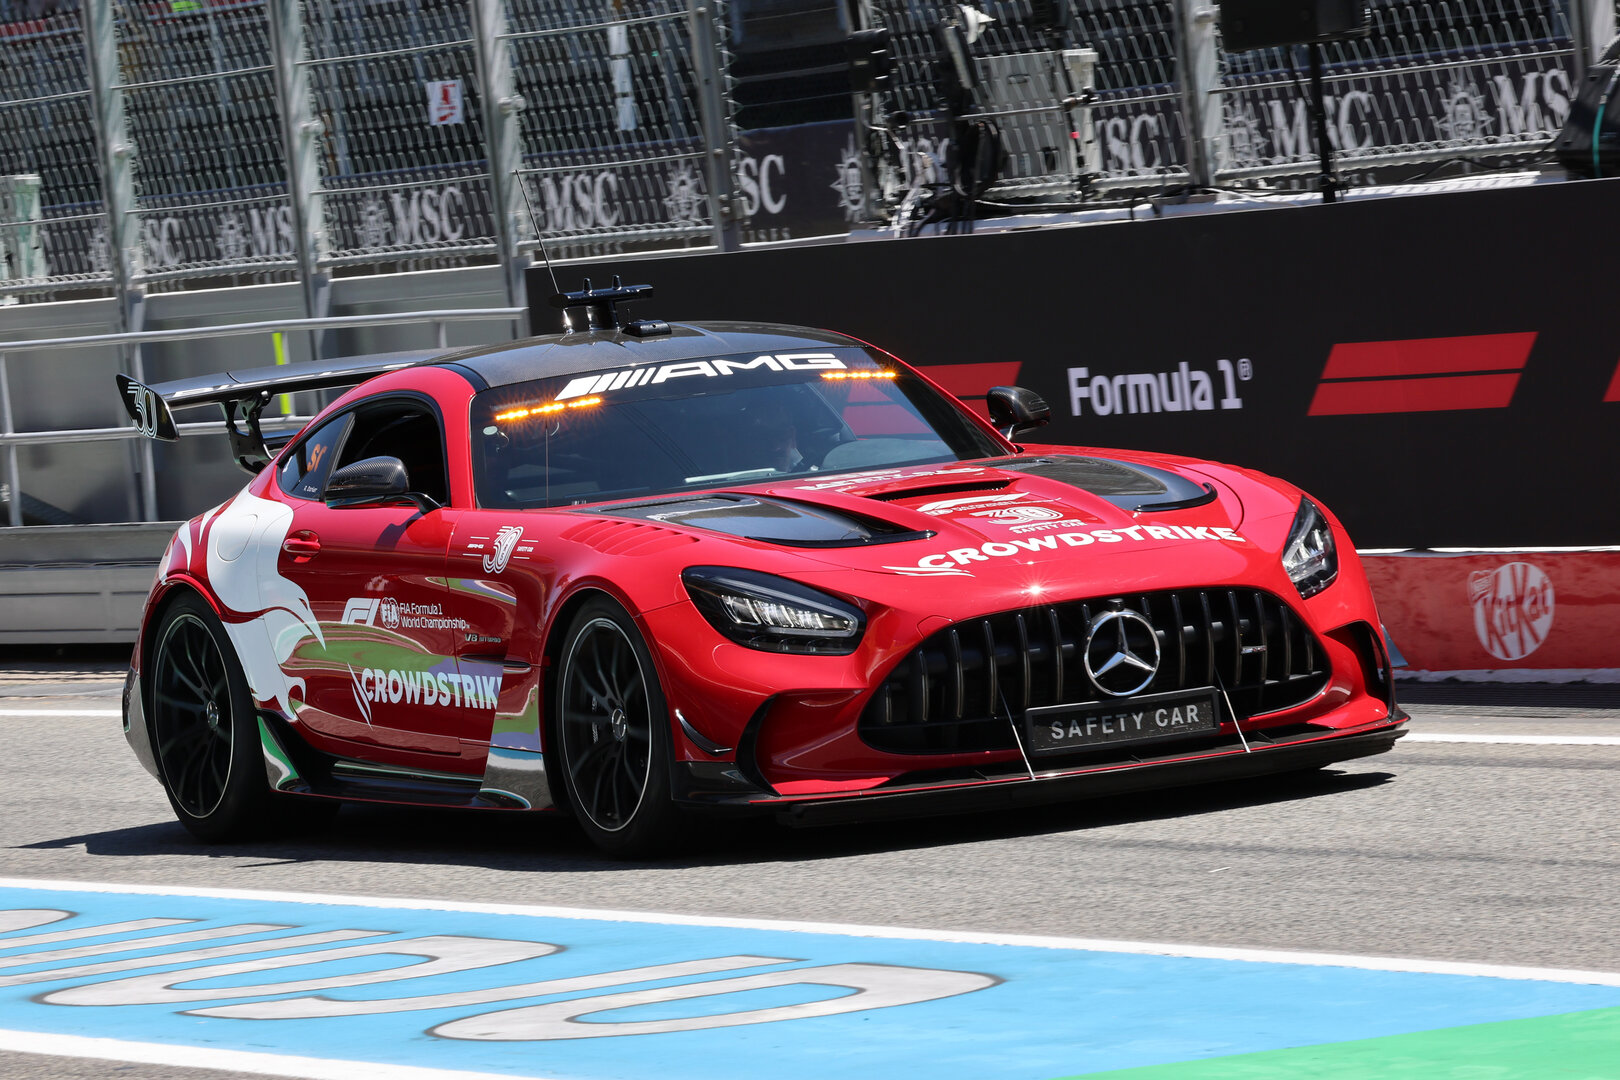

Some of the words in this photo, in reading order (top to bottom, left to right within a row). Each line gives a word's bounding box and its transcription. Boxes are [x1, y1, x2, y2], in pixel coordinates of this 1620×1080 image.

[1493, 68, 1575, 136] MS
[541, 171, 620, 232] MSC
[737, 155, 788, 217] SC
[249, 204, 297, 256] MS
[391, 186, 464, 245] MSC
[651, 353, 848, 384] AMG
[1067, 361, 1215, 416] Formula
[917, 523, 1247, 570] CROWDSTRIKE
[400, 602, 410, 614] FIA
[411, 603, 437, 615] Formula
[437, 603, 443, 615] 1
[400, 616, 420, 628] World
[361, 667, 503, 710] CROWDSTRIK
[1051, 711, 1144, 740] SAFETY
[1155, 704, 1200, 728] CAR
